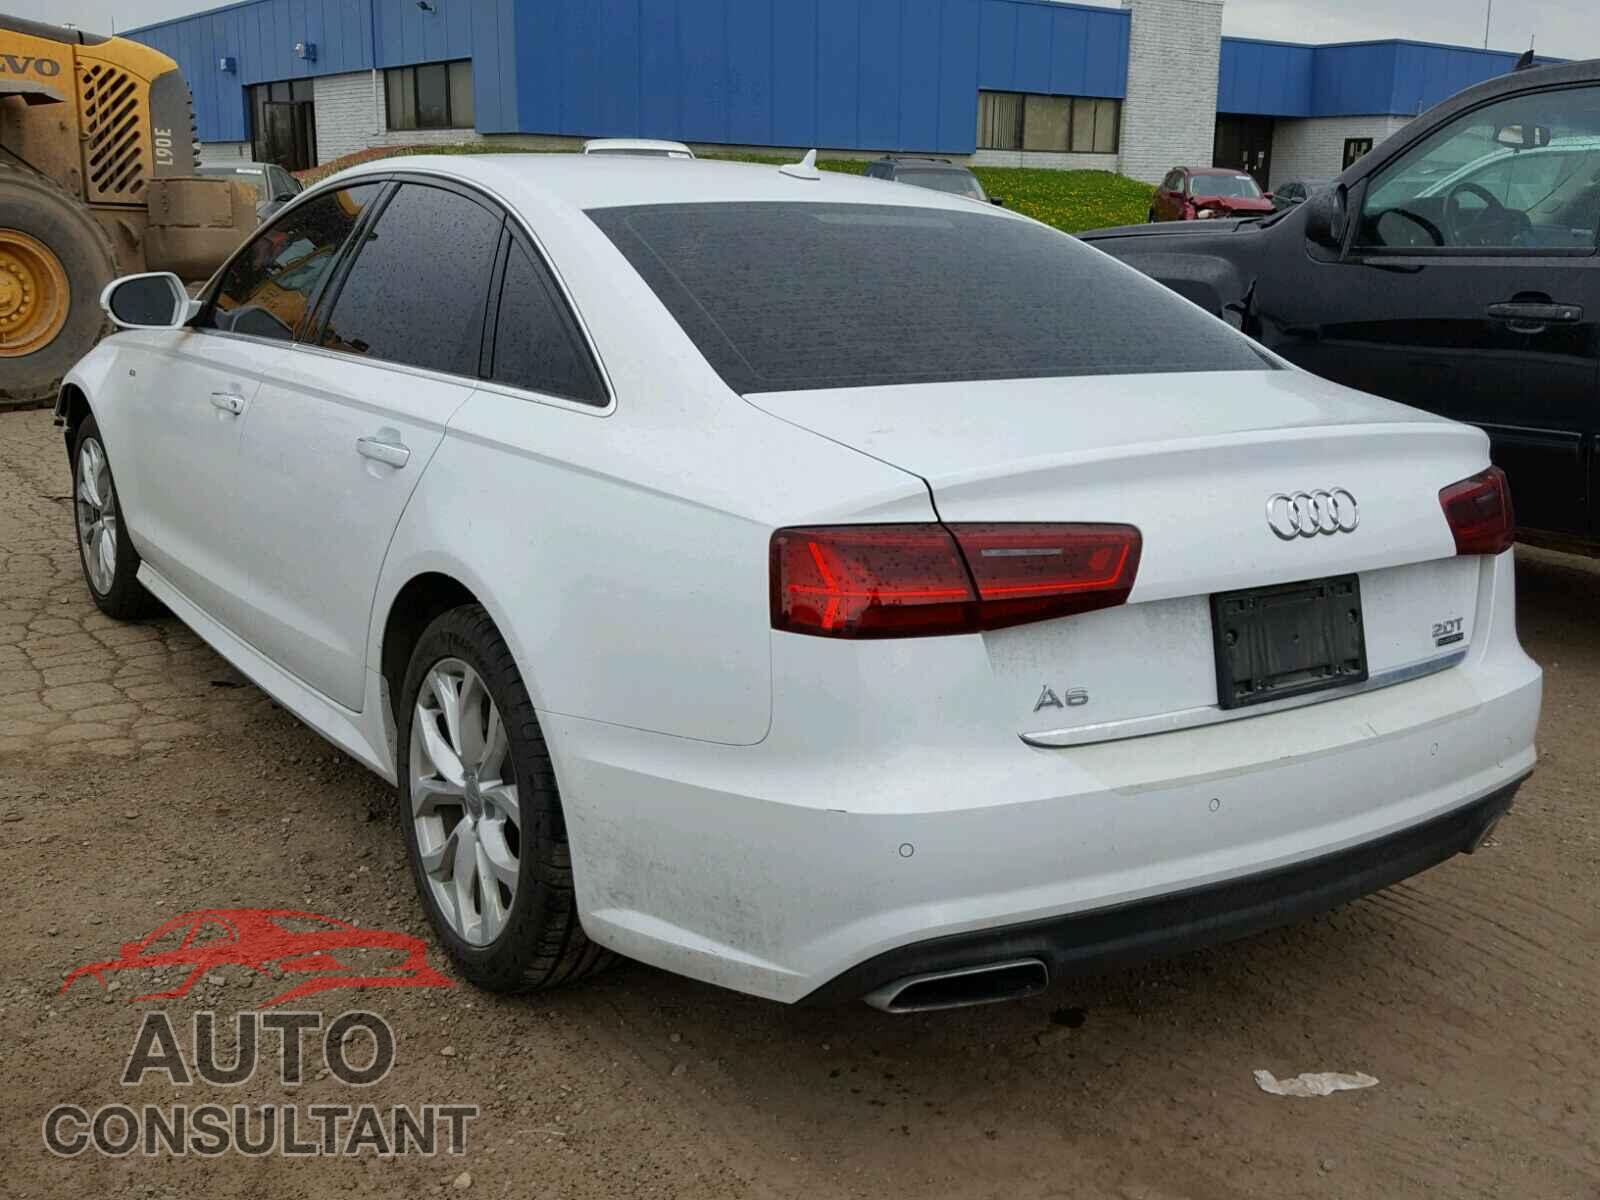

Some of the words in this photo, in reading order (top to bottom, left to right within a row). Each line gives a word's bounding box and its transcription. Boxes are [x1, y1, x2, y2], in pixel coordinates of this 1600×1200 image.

[0, 54, 60, 77] VO
[154, 127, 173, 166] L90E
[1033, 684, 1088, 713] A6
